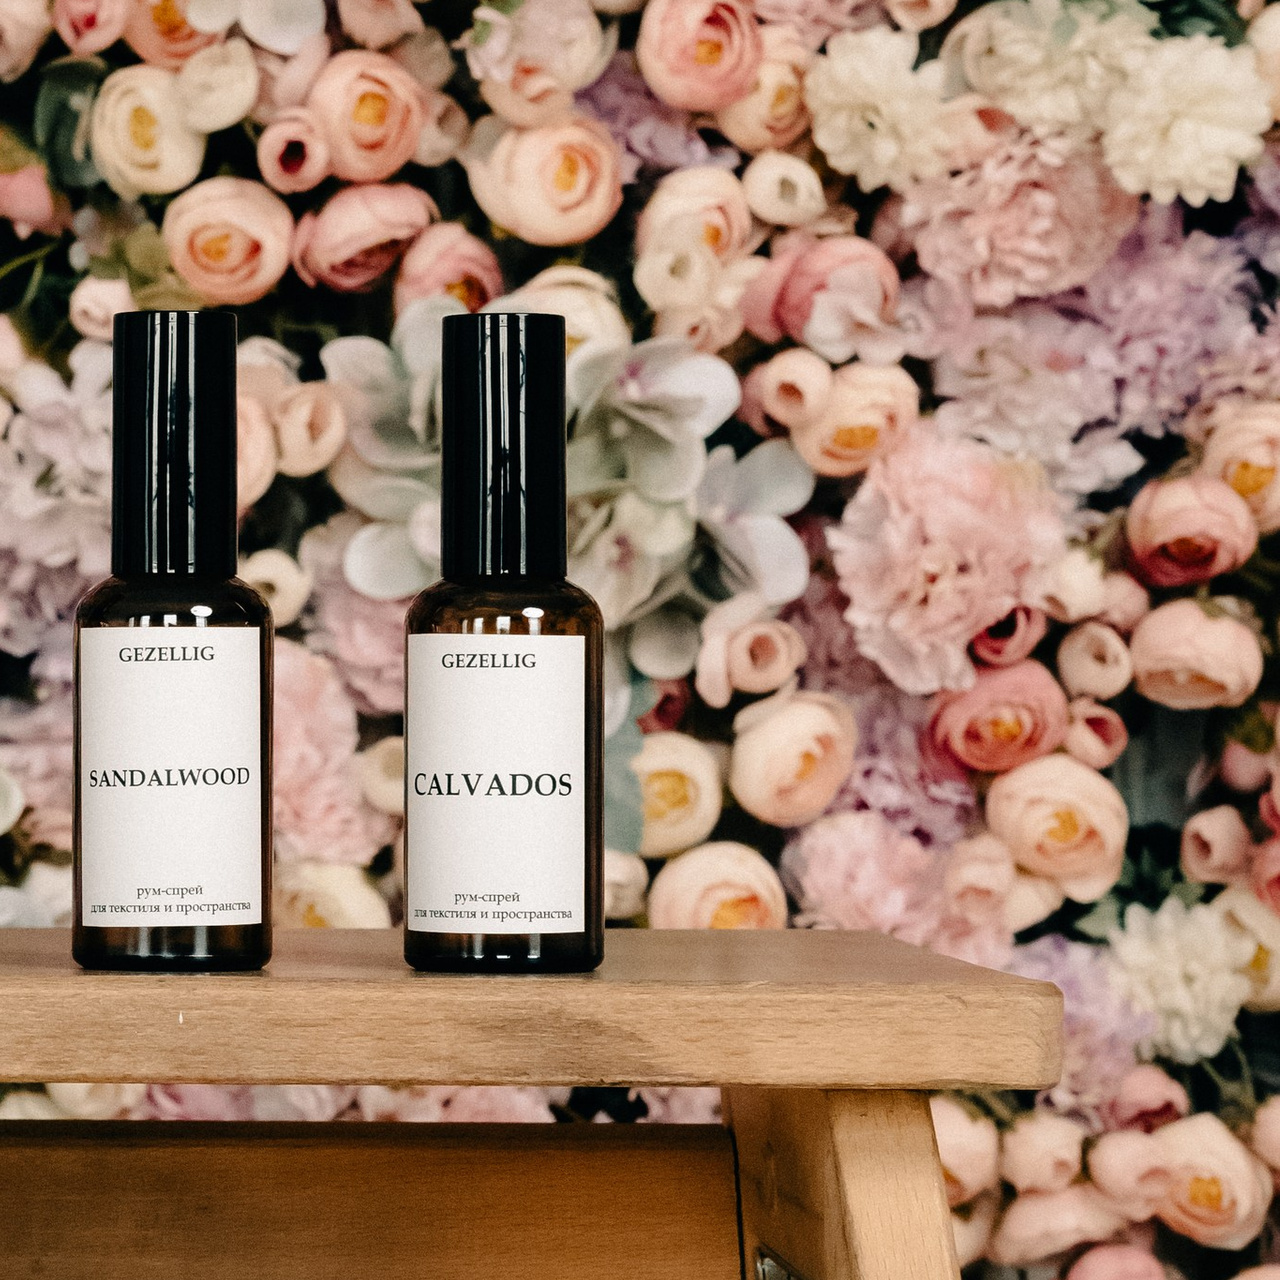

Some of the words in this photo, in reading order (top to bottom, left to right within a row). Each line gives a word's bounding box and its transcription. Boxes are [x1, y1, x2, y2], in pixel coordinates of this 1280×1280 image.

[118, 645, 215, 663] GEZELLIG
[441, 653, 537, 669] GEZELLIG
[89, 767, 250, 788] SANDALWOOD
[414, 772, 572, 797] CALVADOS
[137, 884, 203, 898] рум-спрей
[454, 891, 521, 905] рум-спрей
[90, 903, 106, 913] для
[109, 903, 160, 913] текстиля
[164, 904, 172, 913] и
[176, 900, 251, 916] пространства
[414, 909, 427, 918] для
[429, 909, 476, 919] текстиля
[480, 910, 488, 919] и
[492, 909, 572, 922] пространства
